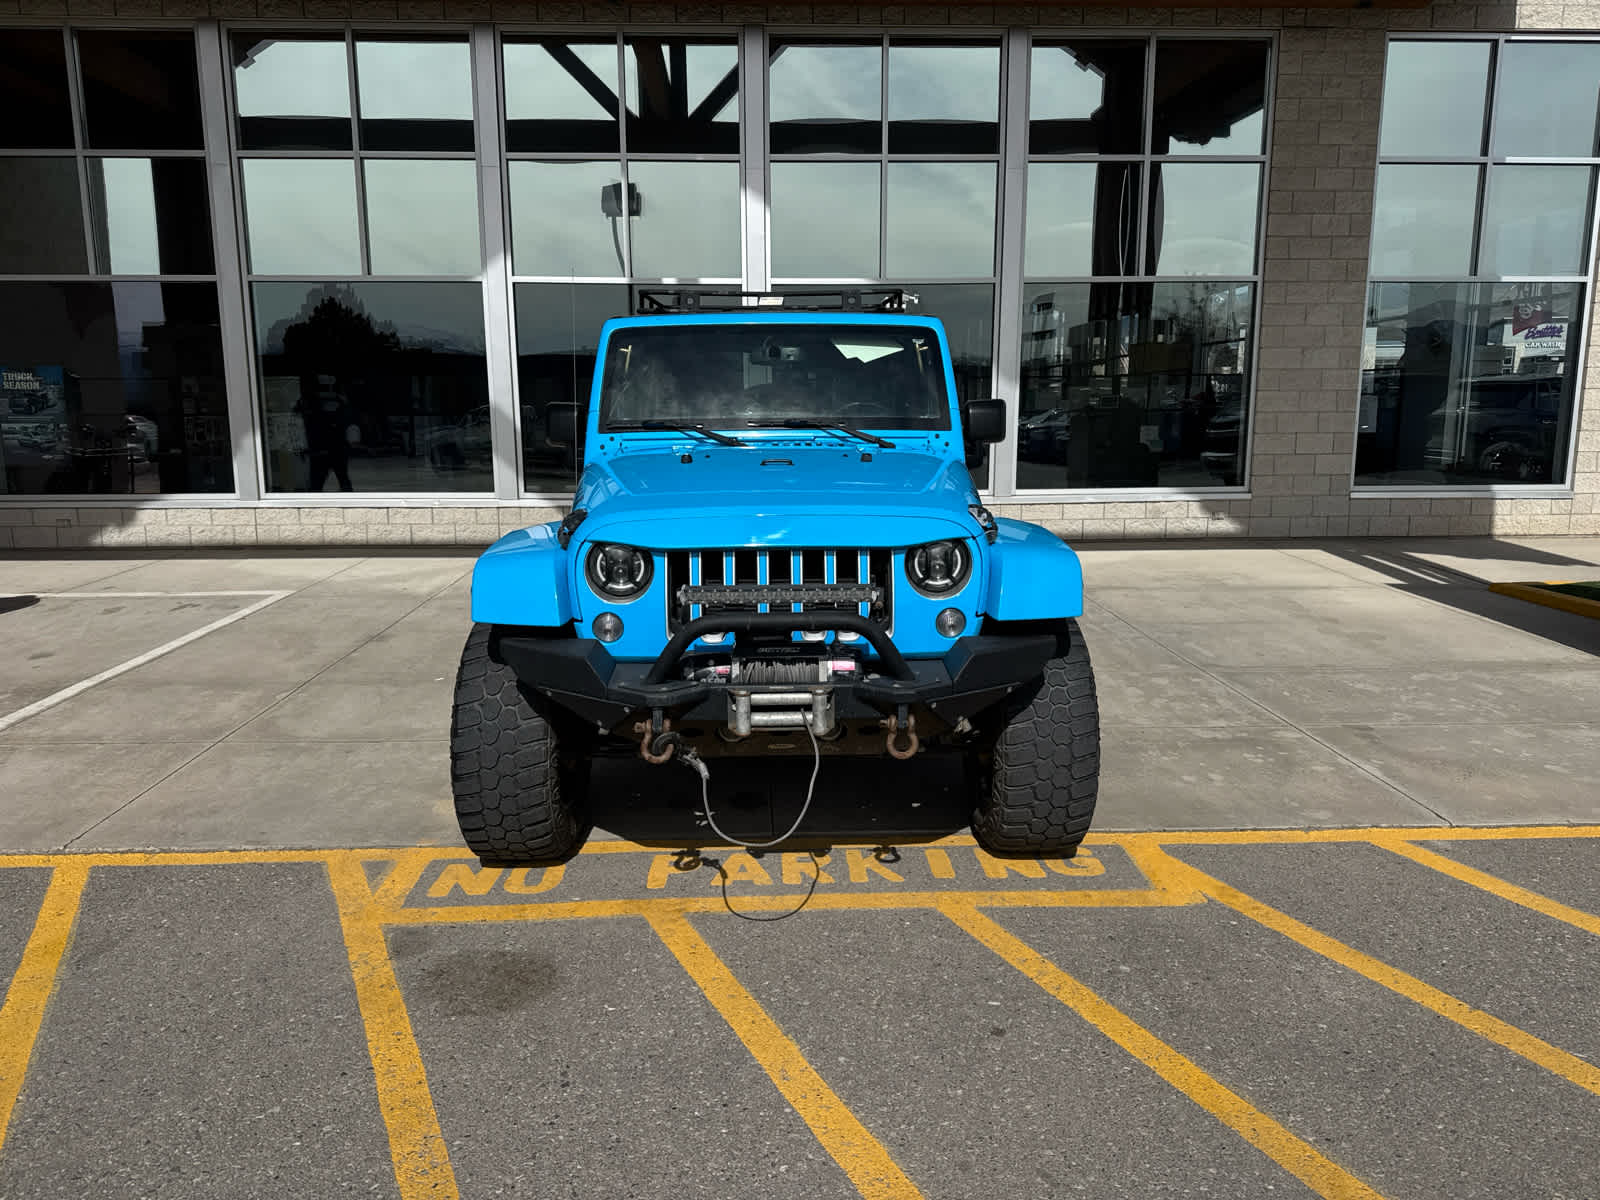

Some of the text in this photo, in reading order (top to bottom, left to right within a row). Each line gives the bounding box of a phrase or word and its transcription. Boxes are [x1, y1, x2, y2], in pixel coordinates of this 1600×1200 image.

[2, 372, 34, 381] TRUCK
[3, 381, 40, 390] SEASON
[427, 846, 1106, 898] NO PARKING
